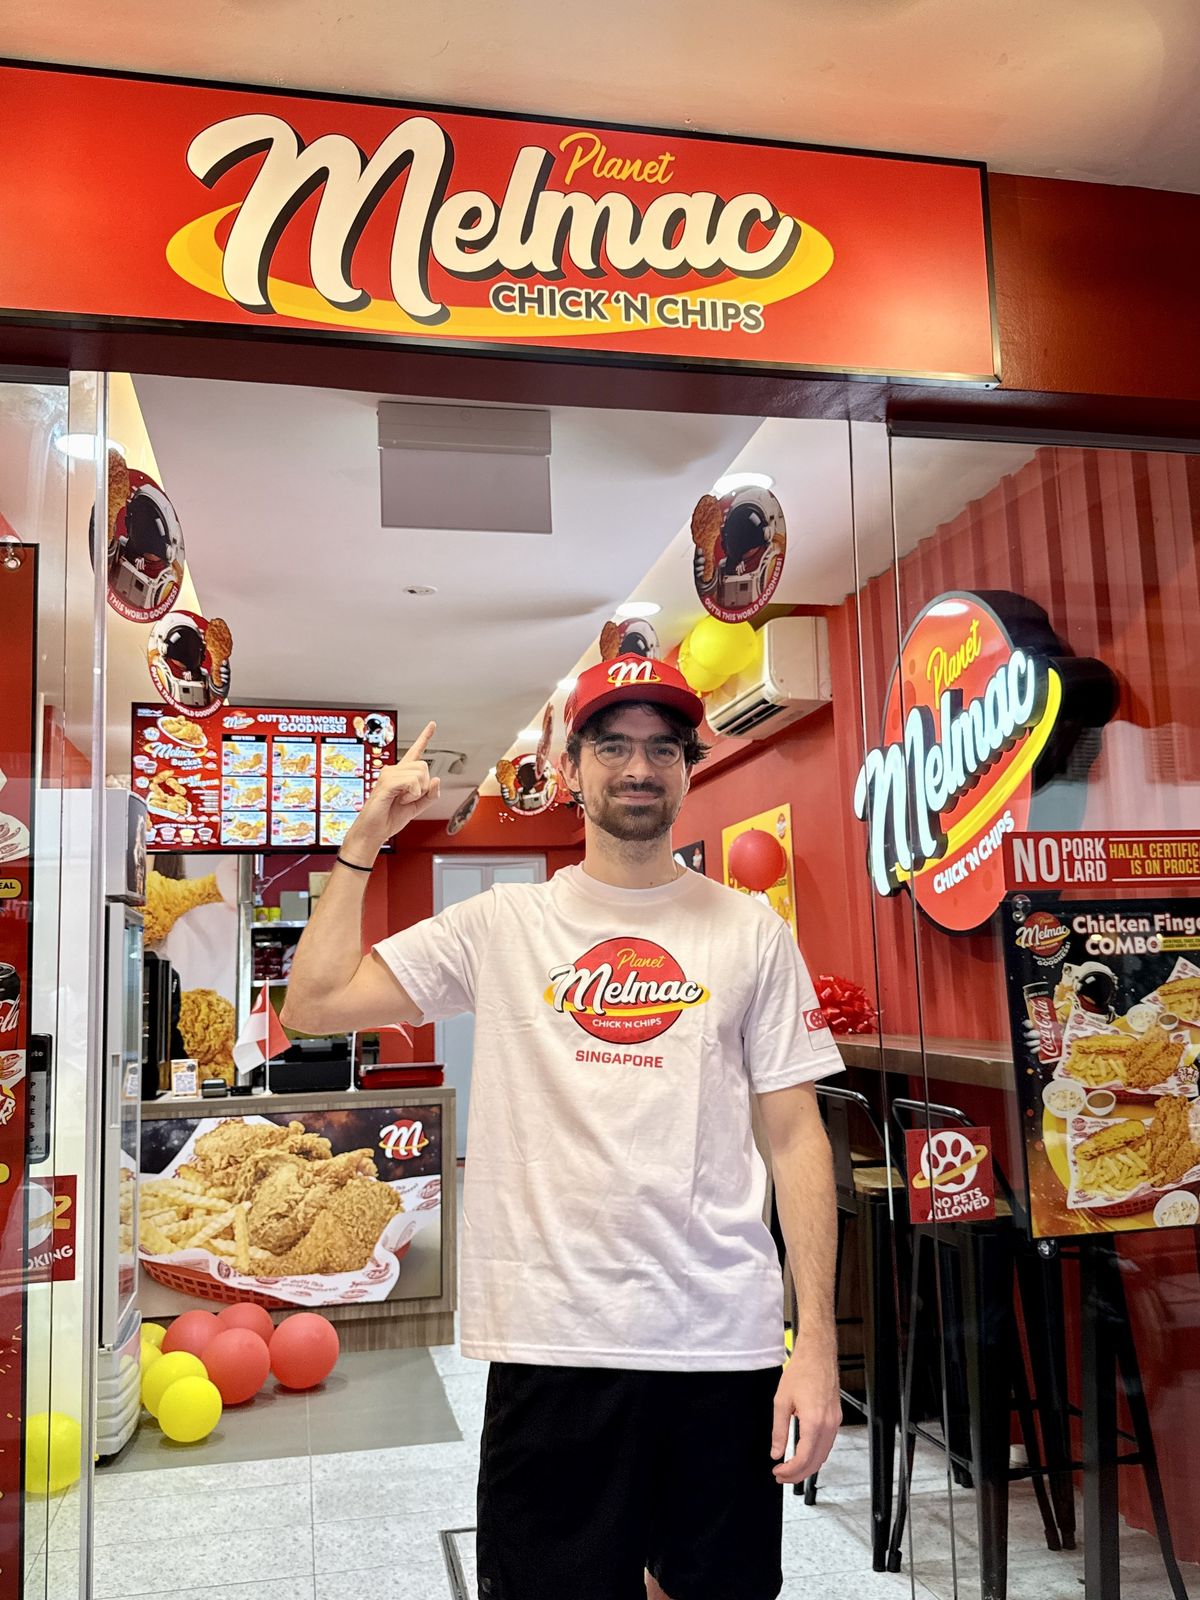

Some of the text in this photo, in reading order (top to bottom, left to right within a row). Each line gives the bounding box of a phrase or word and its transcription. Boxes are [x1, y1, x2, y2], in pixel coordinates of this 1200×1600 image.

[559, 132, 675, 185] Planet
[187, 113, 801, 325] Melmac
[489, 283, 609, 323] CHICK
[655, 297, 765, 334] CHIPS
[109, 593, 124, 611] THIS
[124, 606, 149, 620] WORLD
[704, 597, 721, 618] OUTTA
[722, 611, 737, 621] THIS
[737, 603, 759, 620] WORLD
[607, 660, 653, 687] M
[927, 618, 983, 710] Planet
[257, 714, 347, 725] OUTTA THIS WORLD
[278, 722, 347, 734] GOODNESS!
[853, 650, 1036, 897] Melmac
[933, 857, 969, 894] CHICK
[978, 810, 1015, 860] CHIPS
[1012, 837, 1061, 883] NO
[1061, 837, 1106, 860] PORK
[1109, 842, 1200, 859] HALAL CERTIFIC
[1063, 860, 1107, 883] LARD
[1130, 858, 1200, 876] IS ON PROCE
[1072, 912, 1150, 934] Chicken
[1085, 934, 1162, 956] COMBO
[617, 948, 666, 970] Planet
[549, 963, 704, 1016] Melmac
[592, 1018, 621, 1029] CHICK
[633, 1017, 662, 1028] CHIPS
[575, 1050, 664, 1069] SINGAPORE
[927, 1195, 990, 1220] ALLOWED
[934, 1187, 983, 1210] NO PETS
